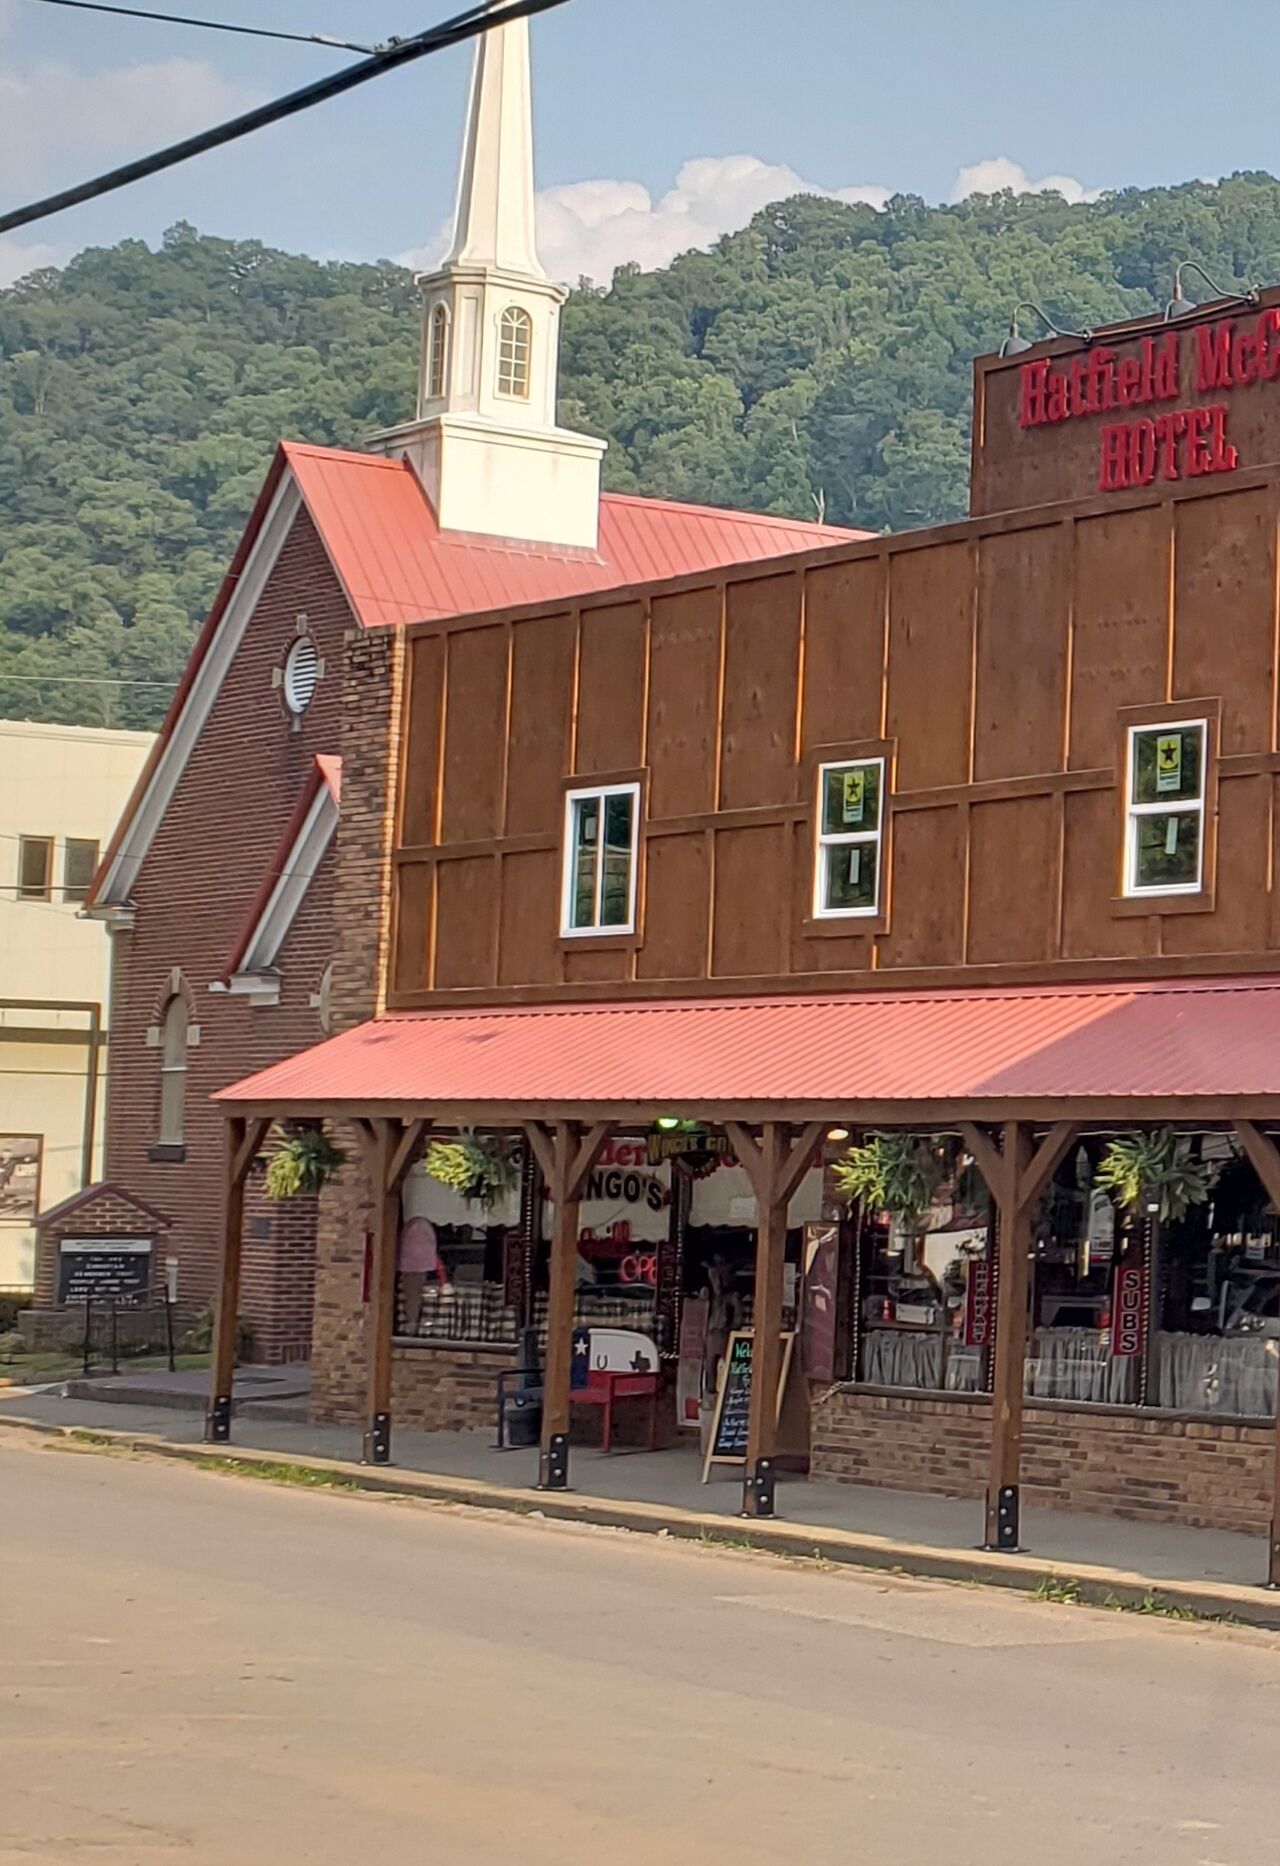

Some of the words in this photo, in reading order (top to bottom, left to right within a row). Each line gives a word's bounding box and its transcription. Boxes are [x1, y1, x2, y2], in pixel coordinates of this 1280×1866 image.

[1018, 330, 1179, 430] Hatfield
[1098, 405, 1239, 492] HOTEL
[586, 1170, 665, 1212] NGO'S
[972, 1262, 989, 1344] BREAKFAST
[1120, 1269, 1141, 1353] SUBS
